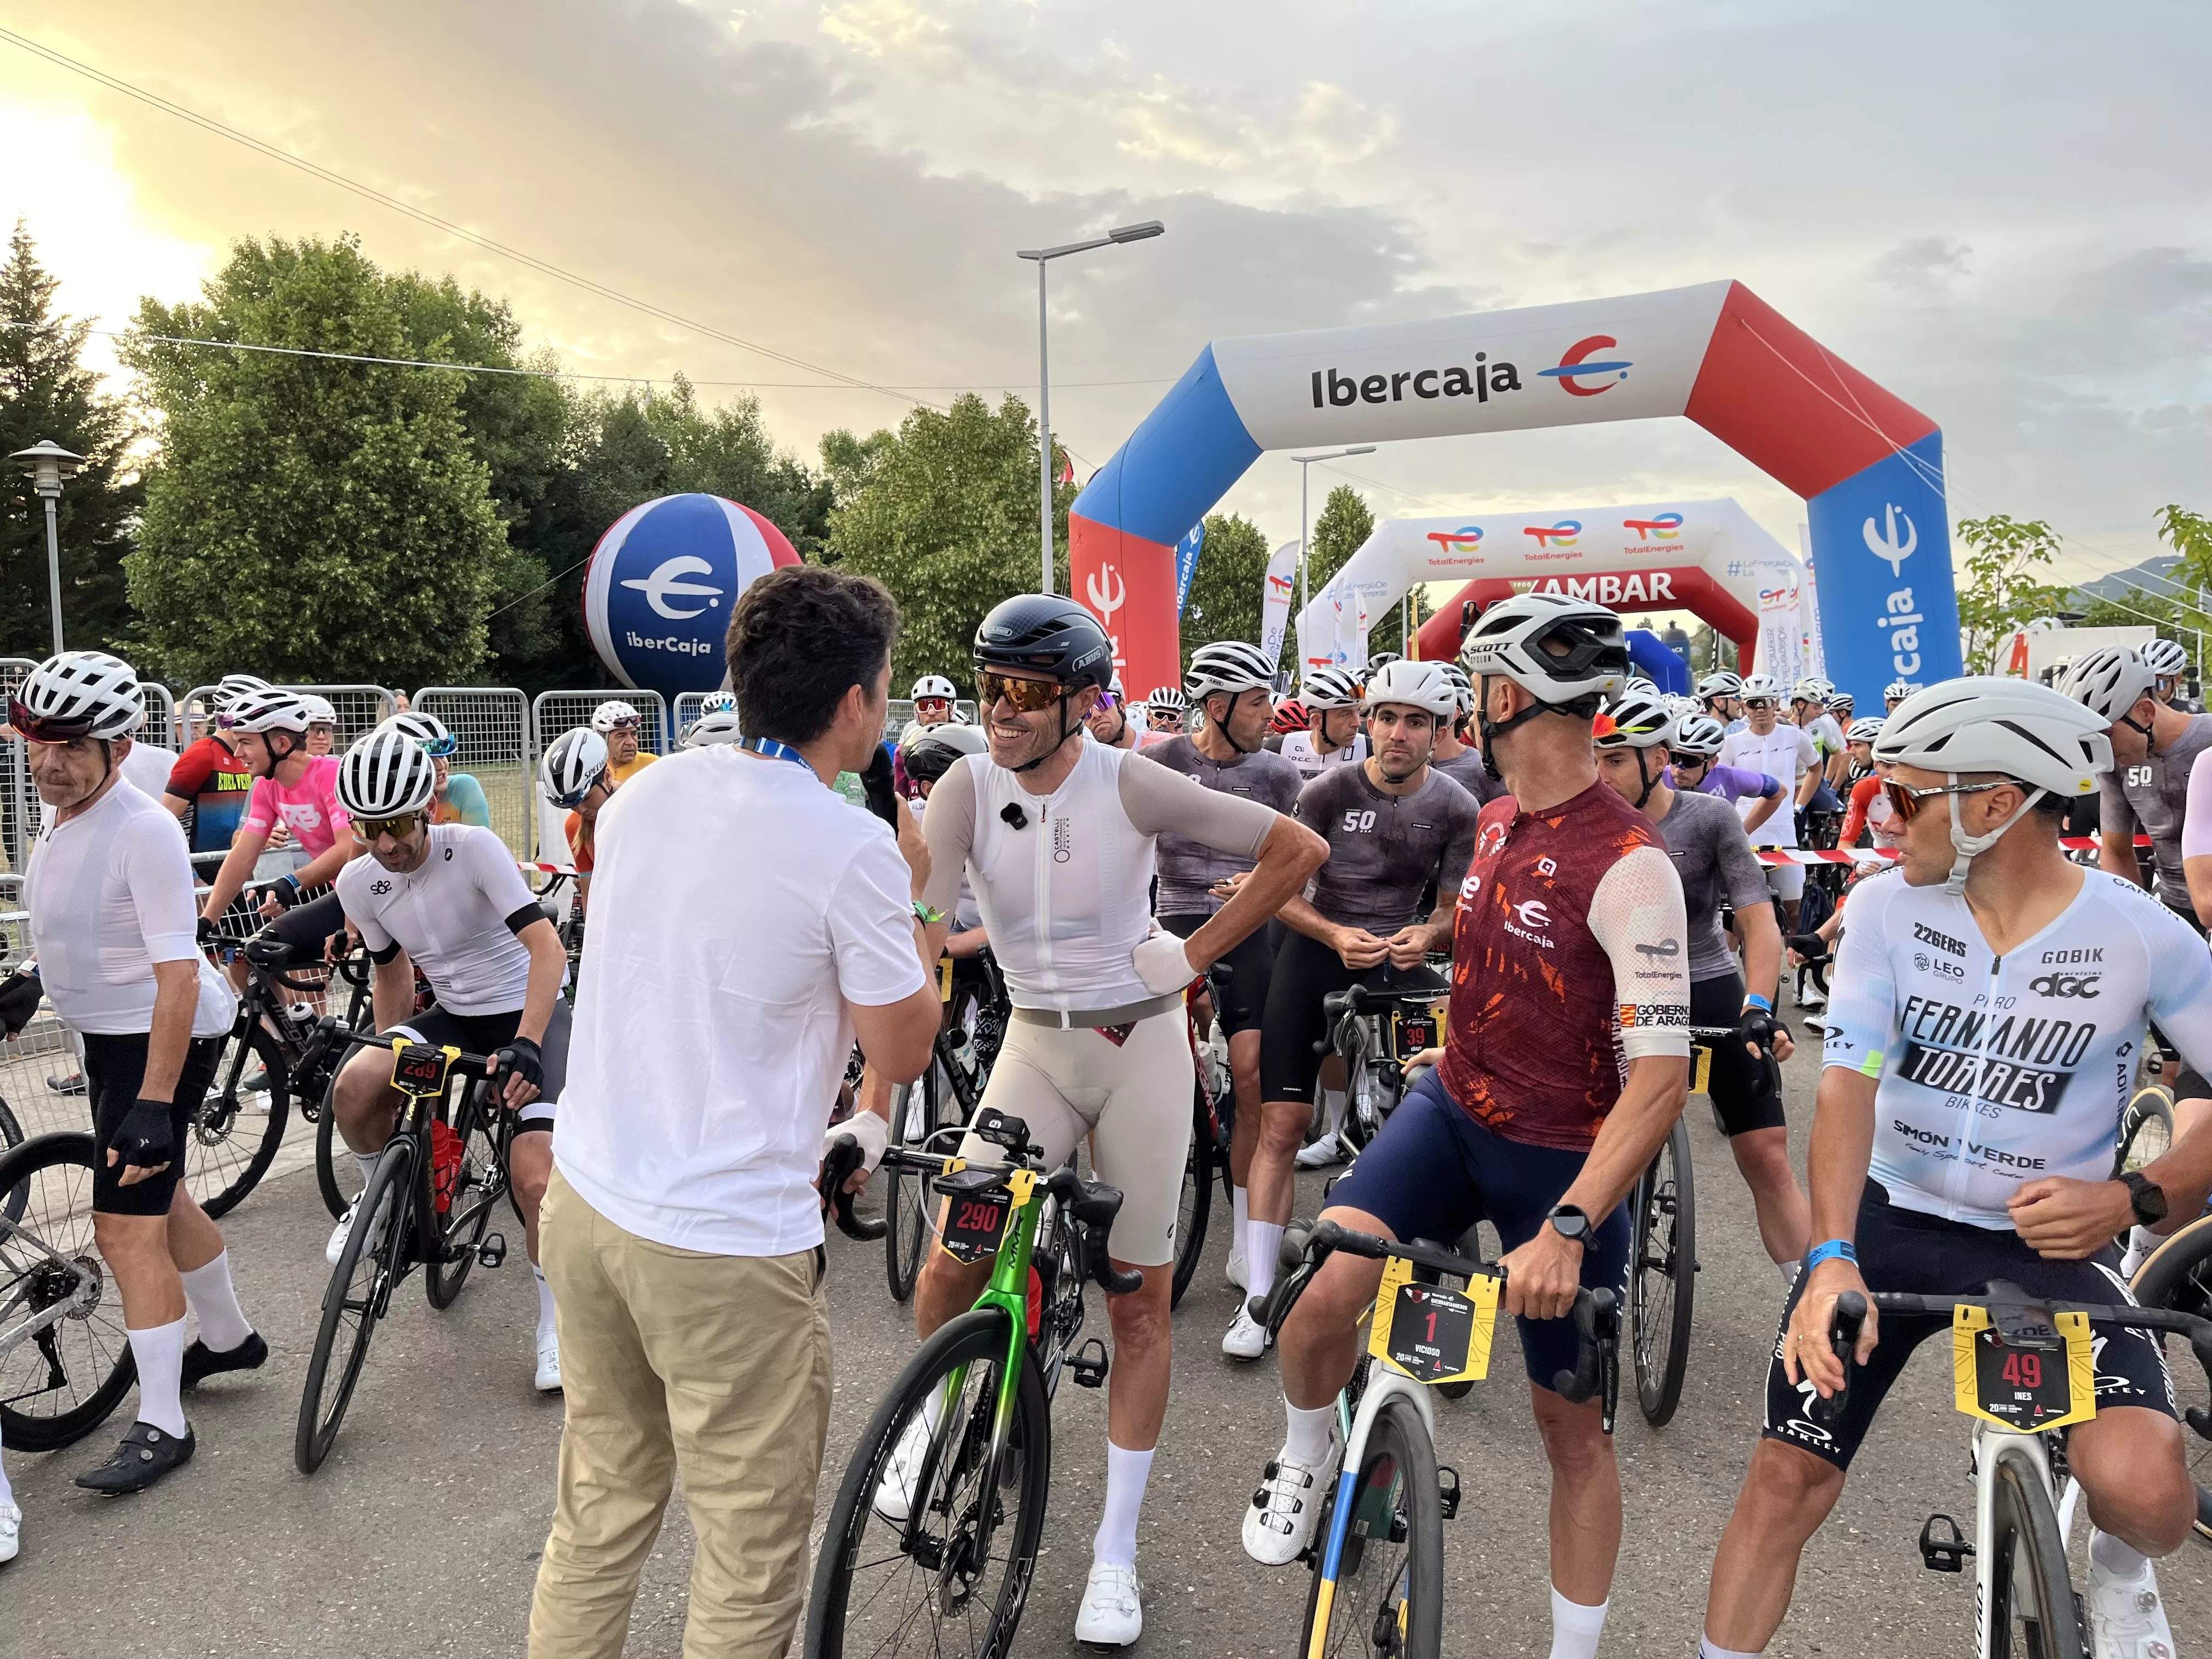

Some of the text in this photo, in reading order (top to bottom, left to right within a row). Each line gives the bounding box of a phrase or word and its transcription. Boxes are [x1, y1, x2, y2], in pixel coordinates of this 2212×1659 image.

[1312, 352, 1522, 408] Ibercaja
[1524, 551, 1583, 561] TotalEnergies
[1624, 544, 1684, 554] TotalEnergies
[1427, 557, 1485, 566] TotalEnergies
[1542, 573, 1677, 603] AMBAR
[627, 631, 711, 657] iberCaja
[1470, 642, 1513, 654] SCOTT
[1077, 648, 1103, 670] ABUS
[1470, 655, 1491, 664] CYCLON
[257, 721, 275, 731] SMITH
[2129, 765, 2153, 787] 50
[1342, 810, 1376, 833] 50
[2113, 878, 2180, 922] GARMIN
[1504, 921, 1555, 949] Ibercaja
[1914, 922, 1967, 957] 226ERS
[2041, 947, 2104, 964] GOBIK
[1635, 971, 1683, 981] TotalEnergies
[1933, 970, 1963, 984] GRUPO
[1934, 958, 1965, 977] LEO
[1637, 1015, 1655, 1026] DE
[1407, 1028, 1425, 1046] 39
[1900, 995, 2097, 1068] FERNANDO
[1825, 1041, 1855, 1049] LEY
[1911, 1046, 2056, 1110] TORRES
[1945, 1096, 2002, 1119] BIKES
[1957, 1138, 2046, 1171] VERDE
[939, 1186, 960, 1194] GARMIN
[956, 1201, 999, 1232] 290
[1426, 1312, 1437, 1342] 1
[1396, 1352, 1404, 1362] 20
[1415, 1344, 1440, 1357] VICIOSO
[2002, 1353, 2042, 1388] 49
[2015, 1391, 2032, 1401] INES
[1989, 1403, 1999, 1413] 20
[1778, 1425, 1841, 1454] OAKLEY
